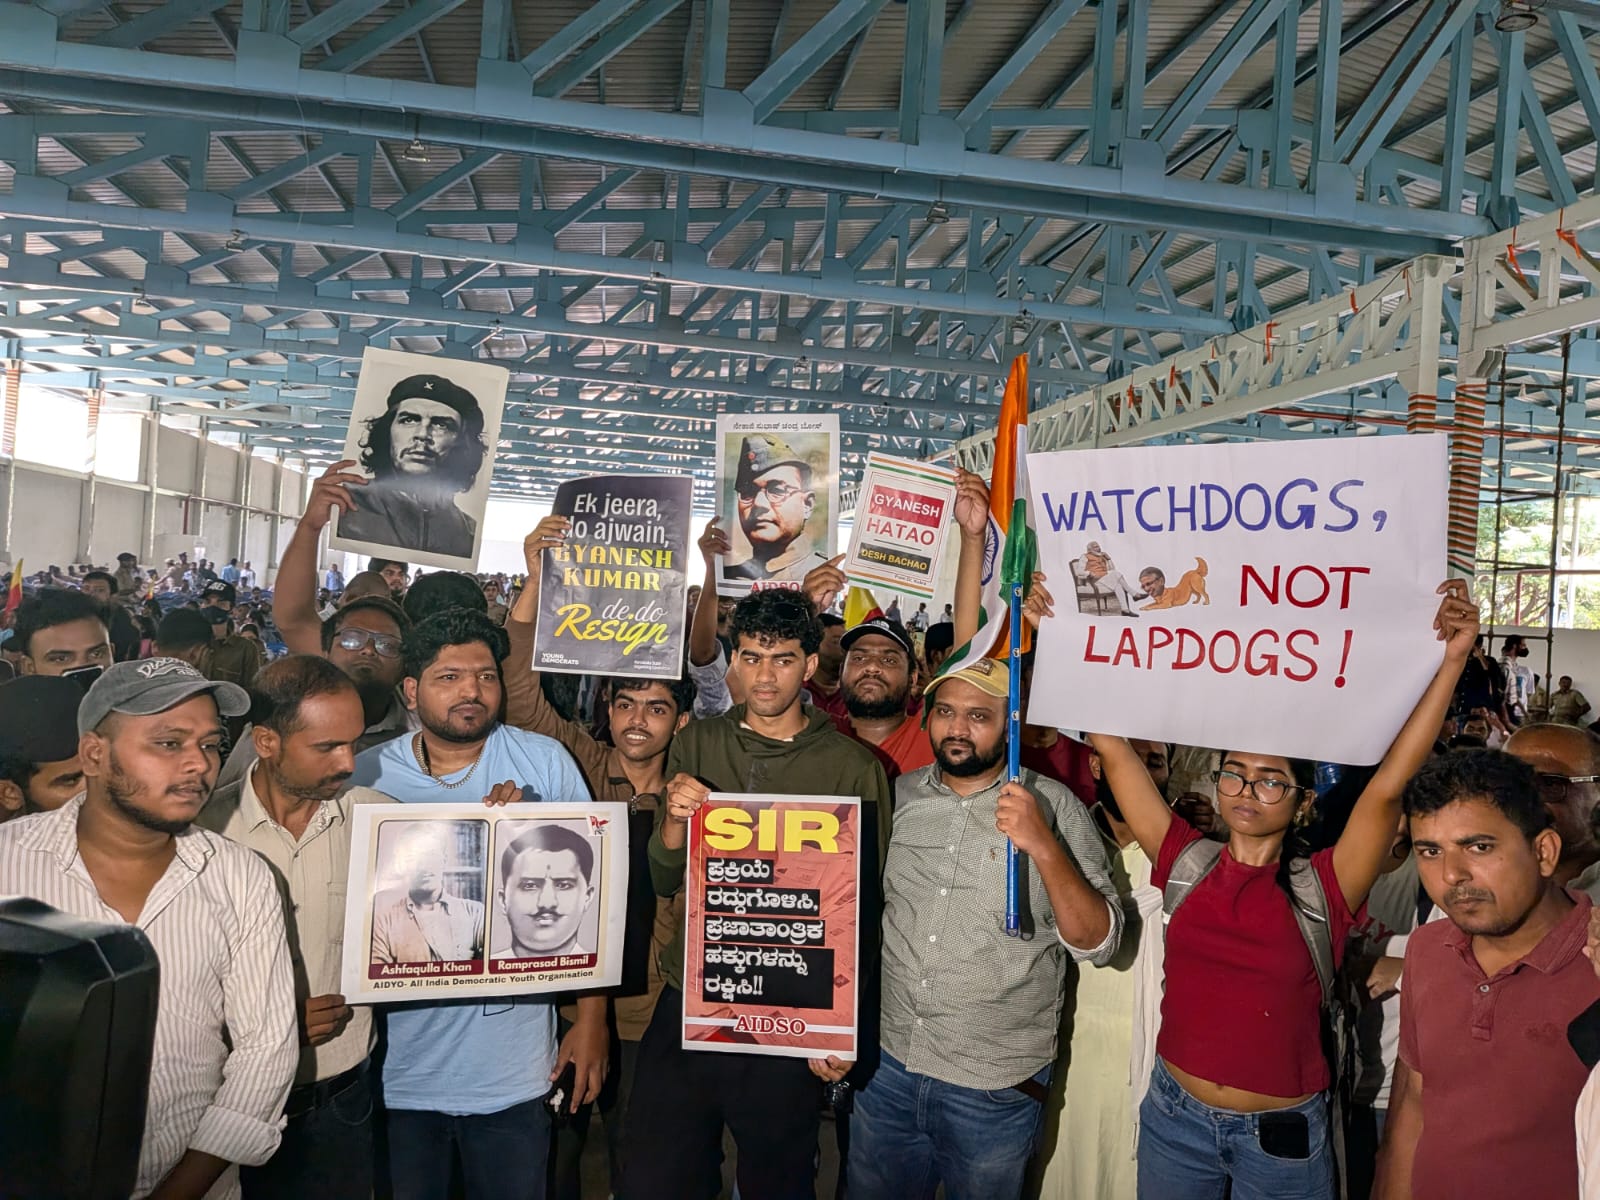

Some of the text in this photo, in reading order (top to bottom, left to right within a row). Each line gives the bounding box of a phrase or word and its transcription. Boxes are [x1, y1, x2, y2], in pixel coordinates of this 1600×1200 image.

[574, 493, 662, 521] Ek jeera,
[874, 493, 940, 518] GYANESH
[1041, 478, 1388, 533] WATCHDOGS,
[594, 517, 670, 548] ajwain,
[866, 517, 935, 546] HATAO
[554, 543, 673, 568] GYANESH
[861, 548, 928, 571] DESH BACHAO
[563, 567, 661, 591] KUMAR
[1239, 565, 1371, 609] NOT
[601, 598, 669, 623] de do
[554, 603, 669, 656] Resign
[541, 657, 579, 666] DEMOCRATS
[542, 652, 564, 660] YOUNG
[1083, 626, 1354, 688] LAPDOGS!
[704, 807, 840, 853] SIR
[707, 858, 770, 883] ಪ್ರಕ್ರಿಯೆ
[707, 887, 818, 915] ರದ್ದುಗೊಳಿಸಿ,
[706, 916, 824, 944] ಪ್ರಜಾತಾಂತ್ರಿಕ
[381, 962, 472, 977] Ashfaqulla Khan
[497, 955, 589, 972] Ramprasad Bismil
[705, 945, 808, 976] ಹಕ್ಕುಗಳನ್ನು
[373, 970, 593, 989] AIDYO- All India Democratic Youth Organisation
[704, 974, 763, 1002] ರಕ್ಷಿಸಿ!!
[735, 1016, 806, 1035] AIDSO
